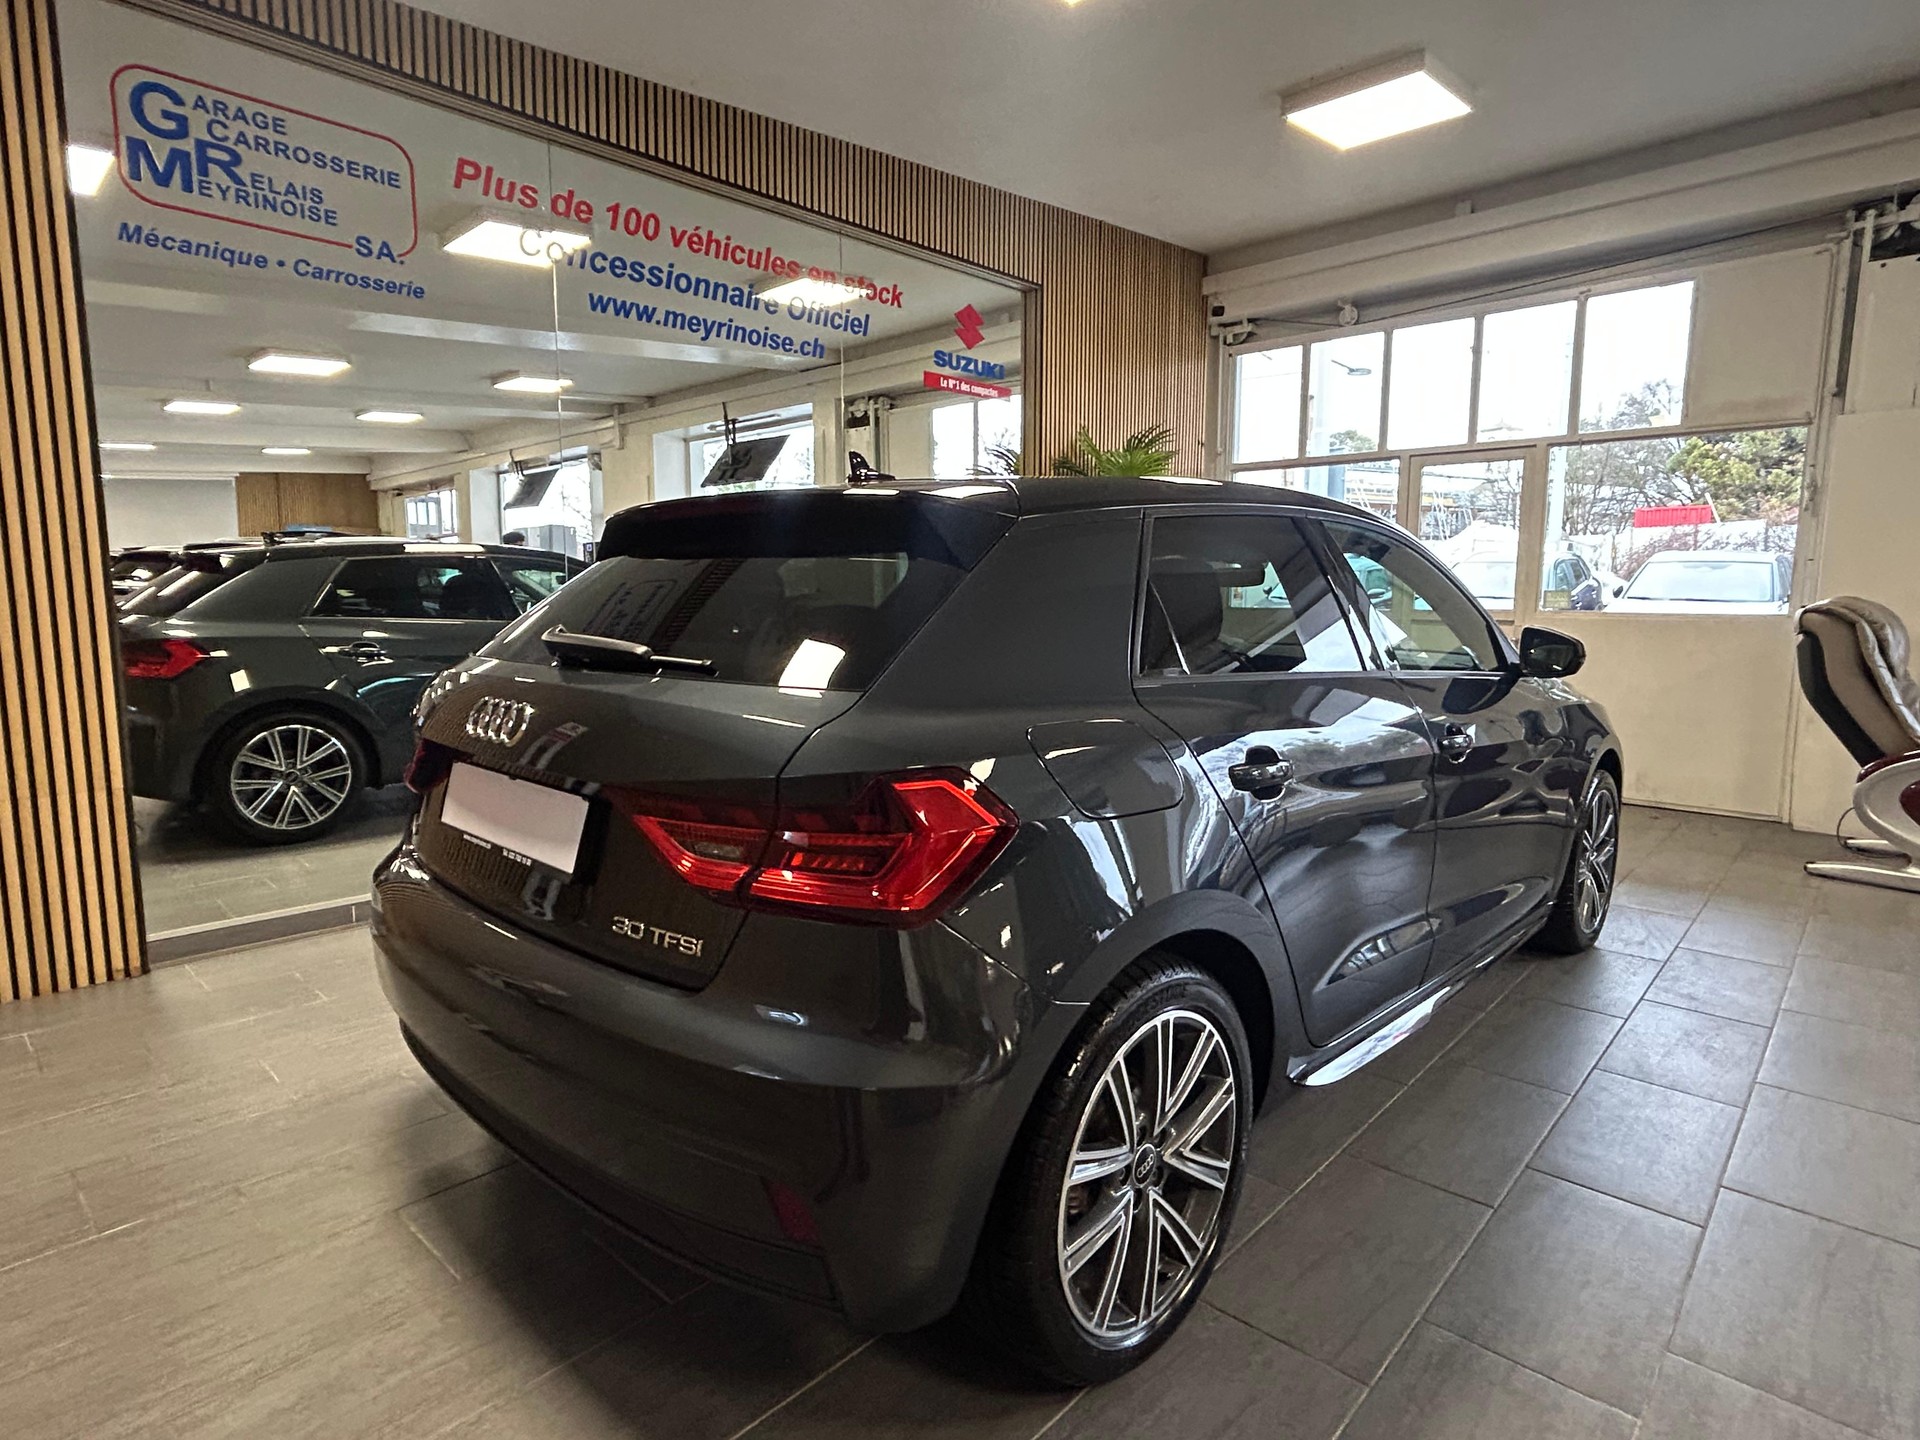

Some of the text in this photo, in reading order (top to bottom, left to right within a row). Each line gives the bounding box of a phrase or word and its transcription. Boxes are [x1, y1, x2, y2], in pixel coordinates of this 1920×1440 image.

[128, 80, 288, 141] GARAGE
[125, 135, 338, 227] MEYRINOISE
[193, 137, 324, 205] RELAIS
[205, 118, 401, 189] CARROSSERIE
[117, 221, 426, 300] Mécanique Carrosserie
[354, 234, 406, 265] SA.
[452, 156, 904, 308] Plus de 100 véhicules en stock
[519, 229, 870, 337] Concessionnaire Officiel
[587, 291, 826, 359] www.meyrinoise.ch
[933, 349, 1005, 380] SUZUKI
[612, 916, 704, 958] 30 TFSI
